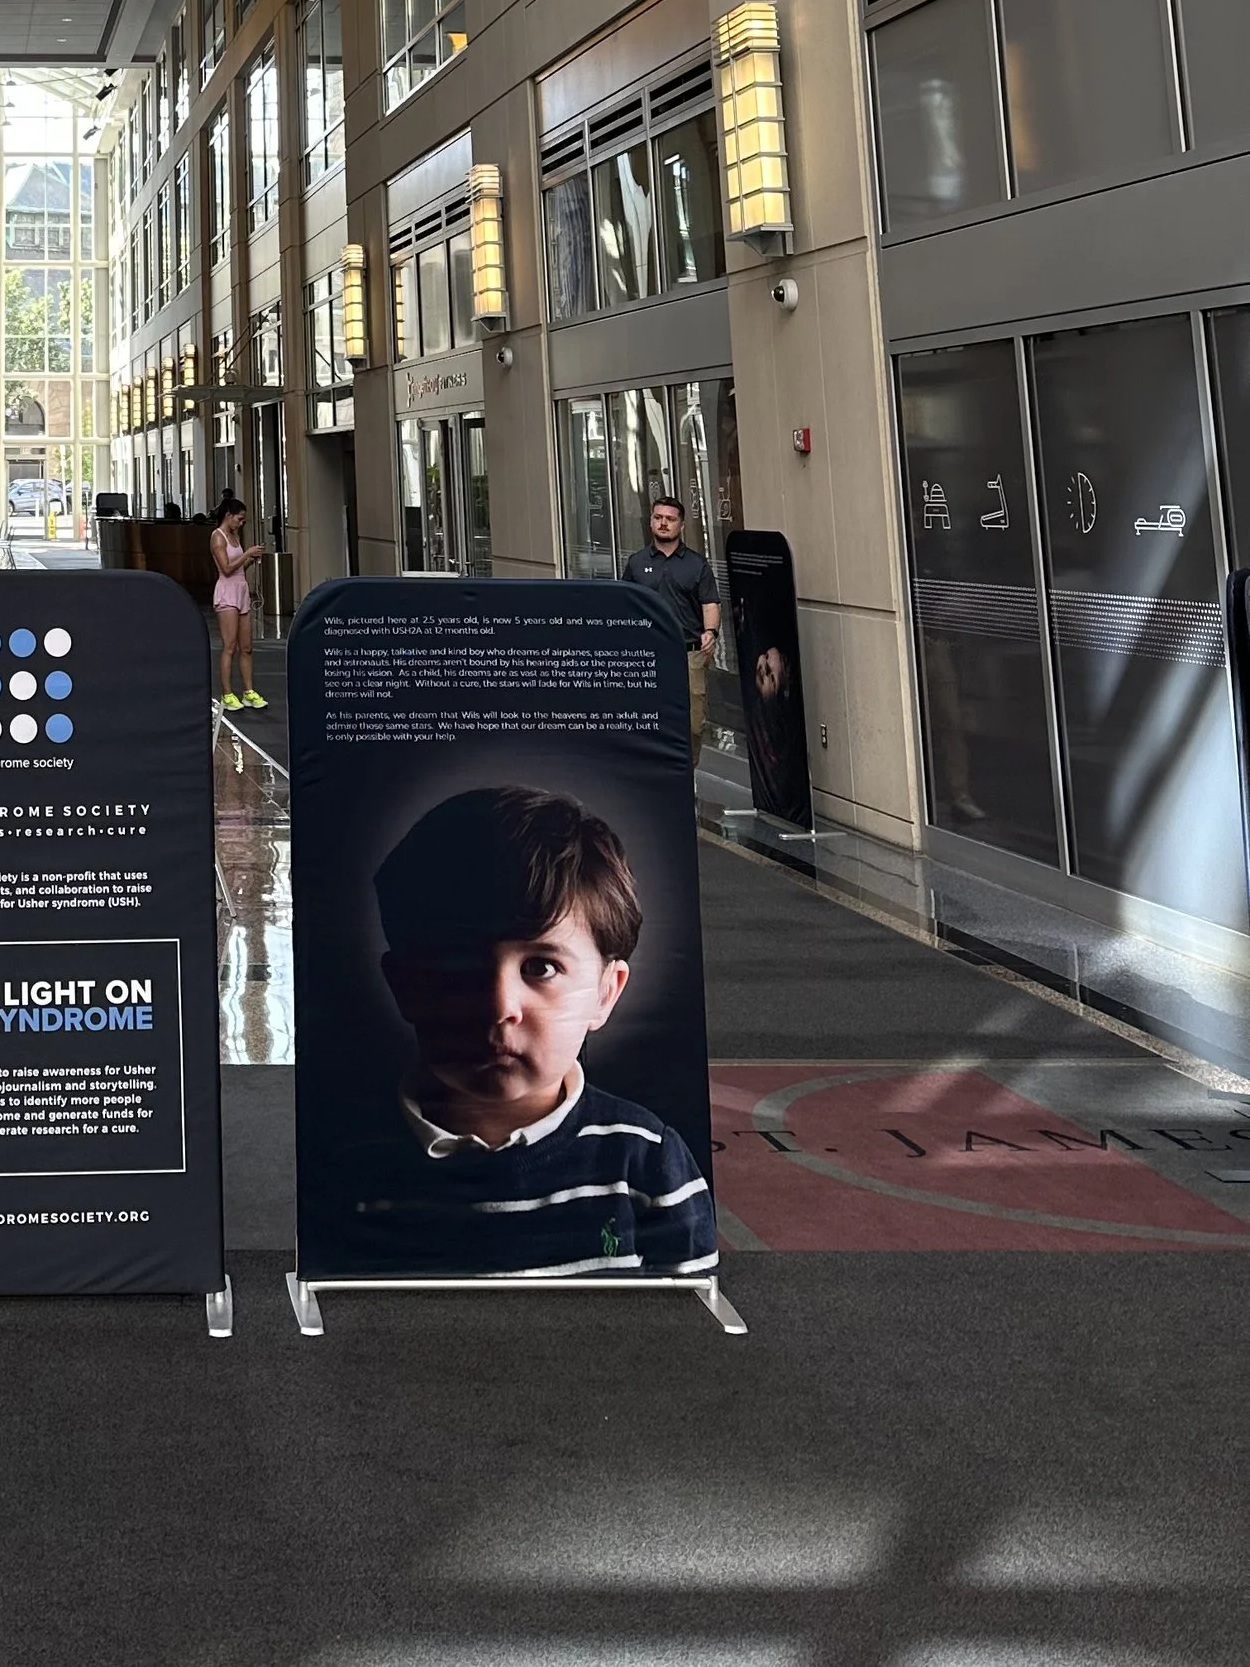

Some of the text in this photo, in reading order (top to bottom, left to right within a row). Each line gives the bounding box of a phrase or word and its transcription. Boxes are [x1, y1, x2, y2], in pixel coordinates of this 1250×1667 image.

[32, 756, 74, 770] society
[62, 803, 149, 816] SOCIETY
[20, 871, 29, 881] is
[31, 873, 38, 881] a
[41, 870, 96, 883] non-profit
[98, 870, 121, 880] that
[123, 871, 148, 880] uses
[14, 884, 35, 895] and
[38, 883, 109, 894] collaboration
[111, 884, 123, 893] to
[126, 882, 152, 893] raise
[0, 898, 15, 908] for
[17, 897, 49, 908] Usher
[51, 896, 105, 909] syndrome
[107, 895, 141, 908] (USH).
[3, 980, 95, 1005] LIGHT
[105, 978, 152, 1004] ON
[12, 1066, 39, 1077] raise
[42, 1067, 101, 1076] awareness
[104, 1064, 120, 1075] for
[123, 1064, 156, 1075] Usher
[64, 1079, 86, 1090] and
[89, 1078, 156, 1091] storytelling.
[8, 1096, 20, 1106] to
[23, 1094, 67, 1107] identify
[70, 1096, 100, 1105] more
[103, 1093, 142, 1106] people
[23, 1109, 45, 1120] and
[48, 1109, 99, 1122] generate
[101, 1107, 134, 1118] funds
[136, 1107, 153, 1118] for
[31, 1123, 79, 1135] research
[82, 1123, 99, 1133] for
[101, 1124, 108, 1133] a
[110, 1124, 139, 1133] cure.
